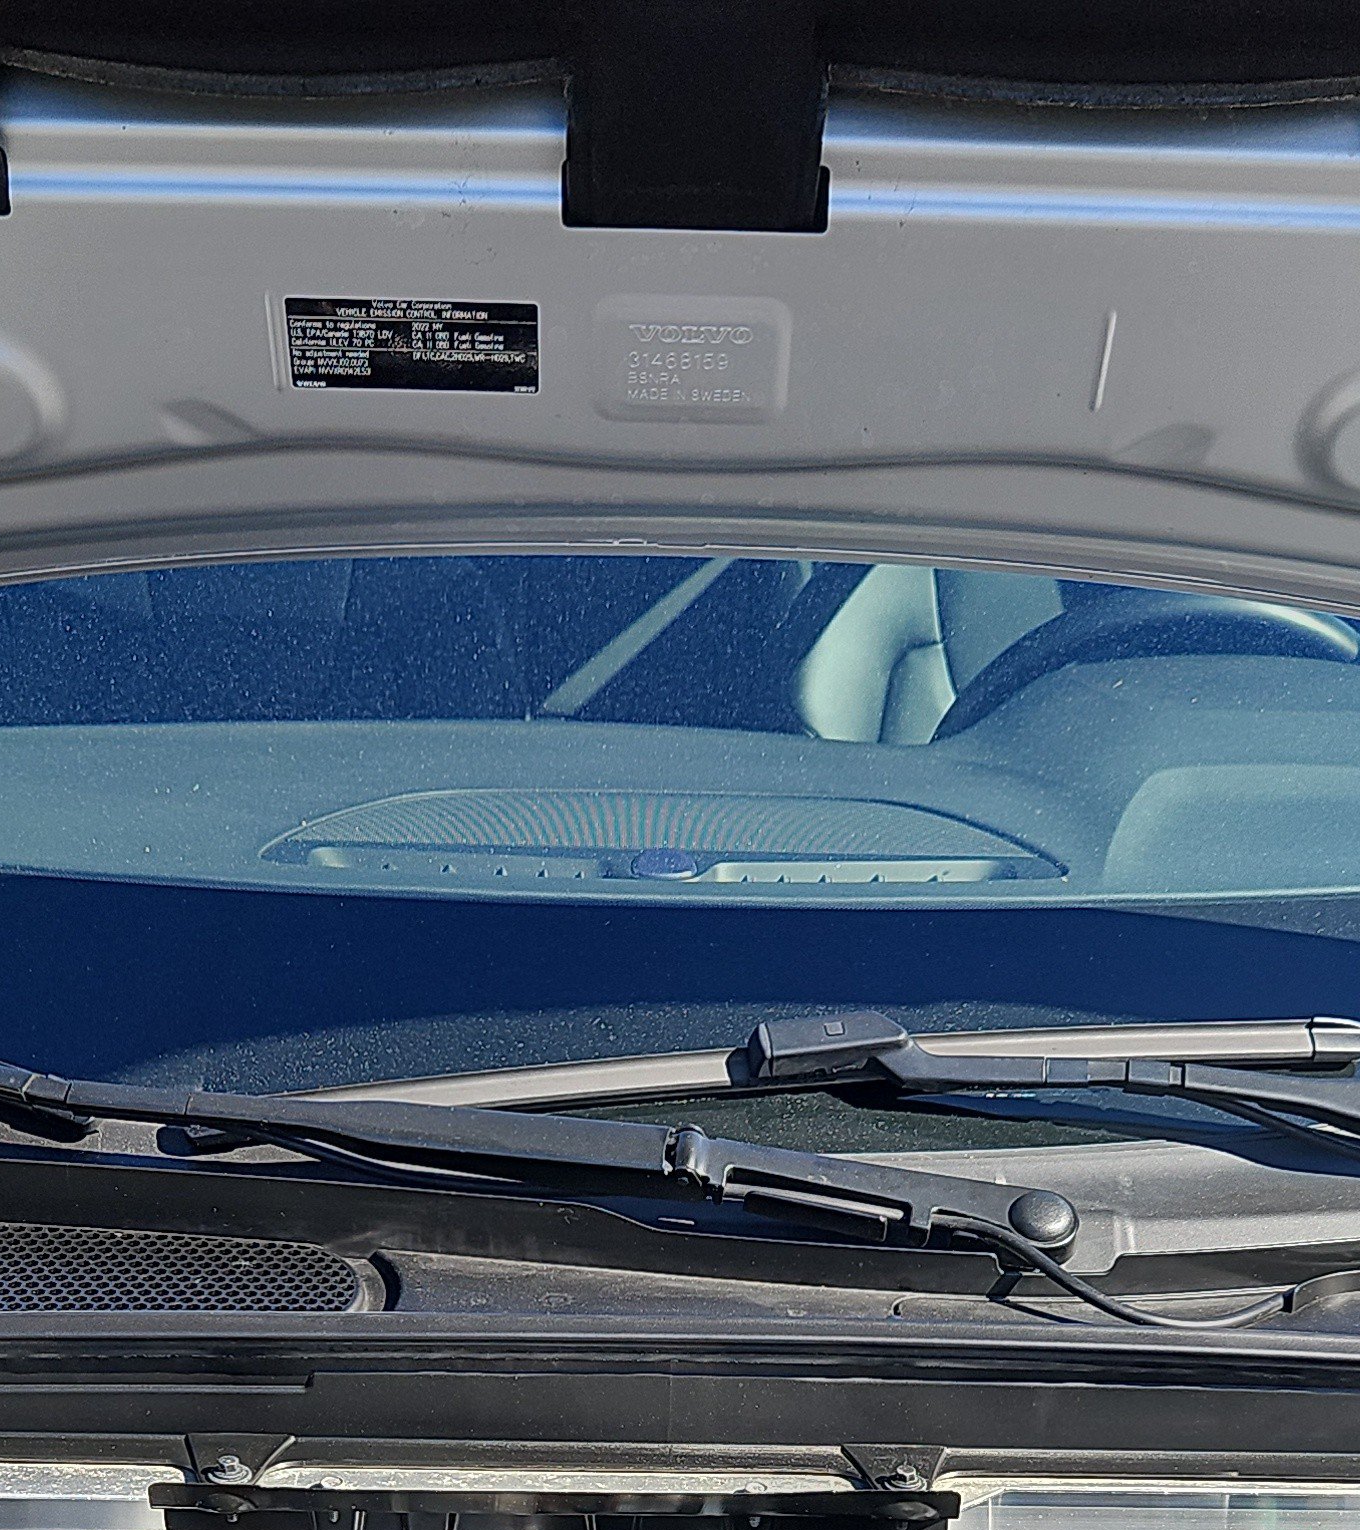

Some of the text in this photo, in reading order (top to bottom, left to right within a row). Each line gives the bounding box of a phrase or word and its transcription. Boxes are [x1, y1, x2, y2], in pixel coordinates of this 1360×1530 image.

[372, 300, 452, 310] Volvo Car Corporation
[336, 308, 488, 320] VEHICLE EMISSION CONTROL INFORMATION
[290, 320, 323, 328] Conforms
[337, 321, 376, 330] regulations
[412, 323, 429, 331] 2022
[307, 329, 349, 337] EPA/Canada
[377, 331, 393, 339] LDV
[474, 333, 504, 341] Gasoline
[628, 324, 753, 344] VOLVO
[291, 338, 326, 346] California
[329, 338, 349, 346] ULEV
[474, 342, 504, 350] Gasoline
[305, 349, 342, 358] adjustment
[345, 350, 370, 358] needed
[627, 388, 751, 403] MADE IN SWEDEN
